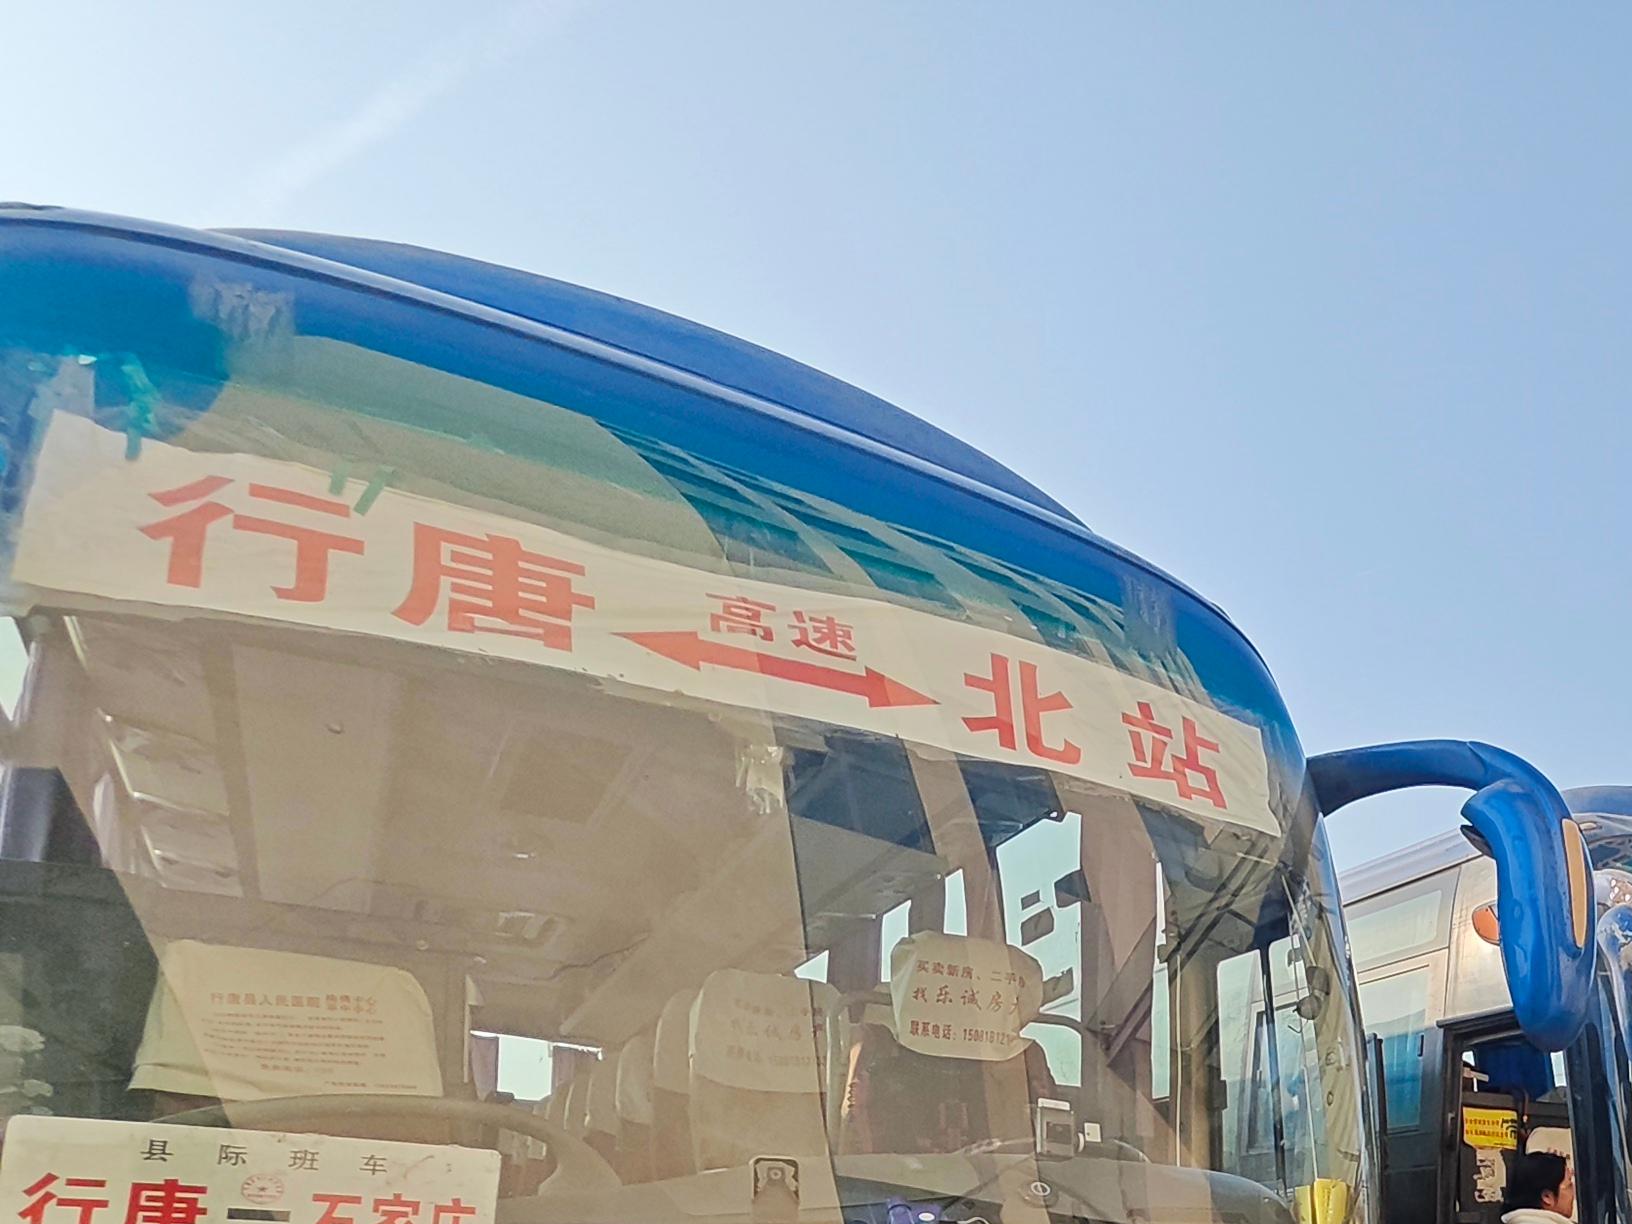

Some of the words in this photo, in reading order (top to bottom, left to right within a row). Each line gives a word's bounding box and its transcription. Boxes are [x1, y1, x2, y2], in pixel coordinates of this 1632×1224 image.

[137, 474, 596, 653] 行唐
[961, 652, 1228, 809] 北站
[705, 592, 858, 661] 高速
[140, 1137, 389, 1176] 县际班车
